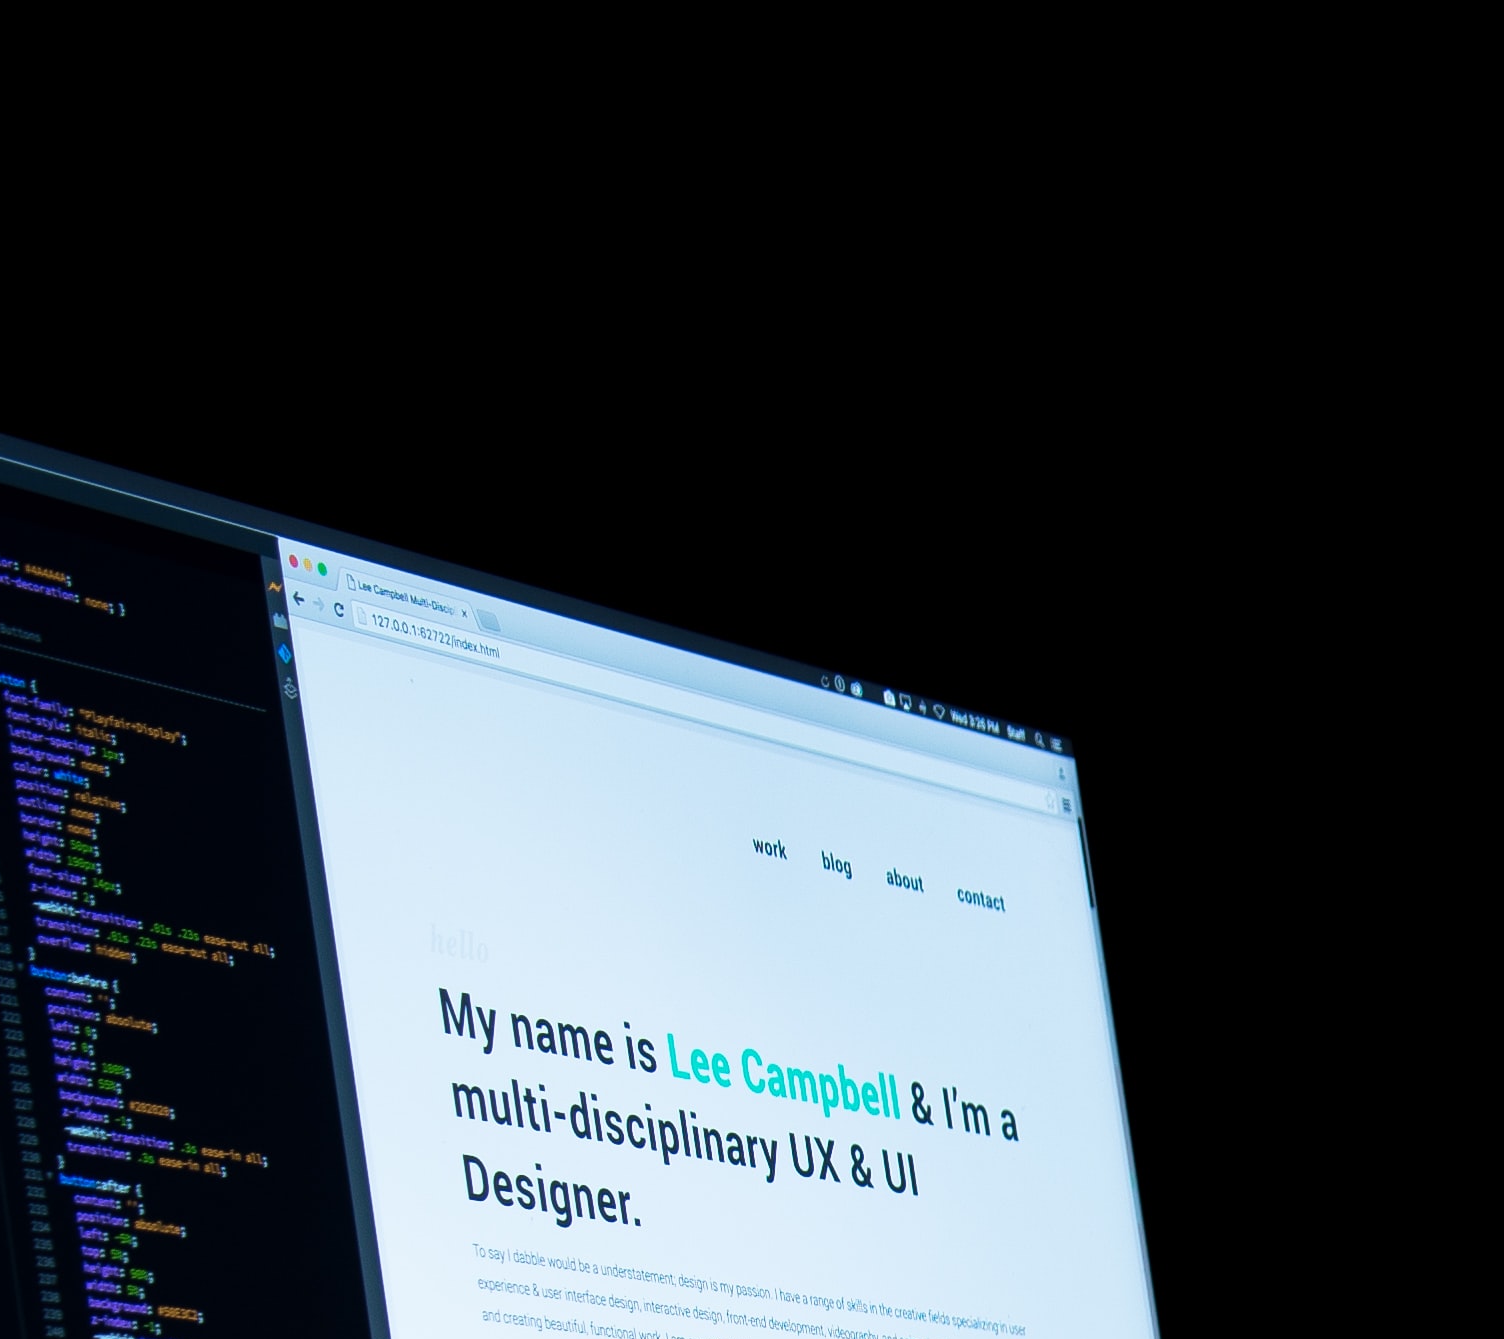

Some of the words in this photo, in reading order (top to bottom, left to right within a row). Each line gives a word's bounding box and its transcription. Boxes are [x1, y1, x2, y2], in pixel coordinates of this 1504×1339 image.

[358, 578, 372, 594] Lee
[373, 583, 409, 602] Campbell
[372, 613, 500, 659] 127.0.0.1:62722/index.html
[753, 838, 787, 859] work
[821, 851, 853, 879] blog
[886, 868, 924, 892] about
[957, 886, 1005, 912] contact
[429, 922, 489, 965] hello
[439, 988, 496, 1054] My
[510, 1013, 614, 1065] name
[624, 1021, 657, 1073] is
[667, 1033, 731, 1087] Lee
[741, 1048, 900, 1120] Campbell
[909, 1081, 934, 1126] &
[942, 1087, 990, 1136] I'm
[1001, 1109, 1019, 1142] a
[451, 1079, 778, 1183] multi-disciplinary
[789, 1133, 840, 1183] UX
[851, 1144, 874, 1188] &
[882, 1149, 919, 1196] UI
[462, 1154, 642, 1228] Designer.
[472, 1243, 486, 1258] To
[488, 1249, 505, 1264] say
[513, 1250, 546, 1266] dabble
[548, 1257, 576, 1271] would
[578, 1259, 590, 1273] be
[593, 1264, 599, 1274] a
[601, 1265, 676, 1287] understatement;
[678, 1274, 708, 1293] design
[710, 1278, 718, 1292] is
[720, 1283, 734, 1297] my
[736, 1285, 771, 1299] passion.
[780, 1288, 800, 1304] have
[803, 1295, 808, 1304] a
[810, 1296, 834, 1311] range
[836, 1297, 844, 1310] of
[869, 1305, 877, 1314] in
[879, 1303, 892, 1317] the
[894, 1308, 927, 1322] creative
[928, 1309, 950, 1325] fields
[952, 1317, 998, 1336] specializing
[999, 1320, 1008, 1333] in
[1009, 1325, 1026, 1336] user
[478, 1279, 531, 1295] experience
[532, 1283, 539, 1296] &
[542, 1288, 562, 1299] user
[565, 1288, 606, 1306] interface
[609, 1294, 642, 1313] design,
[643, 1302, 691, 1318] interactive
[693, 1306, 725, 1325] design,
[727, 1309, 766, 1328] front-end
[769, 1317, 826, 1337] development,
[482, 1310, 501, 1322] and
[503, 1313, 542, 1331] creating
[544, 1316, 589, 1335] beautiful,
[591, 1321, 636, 1339] functional
